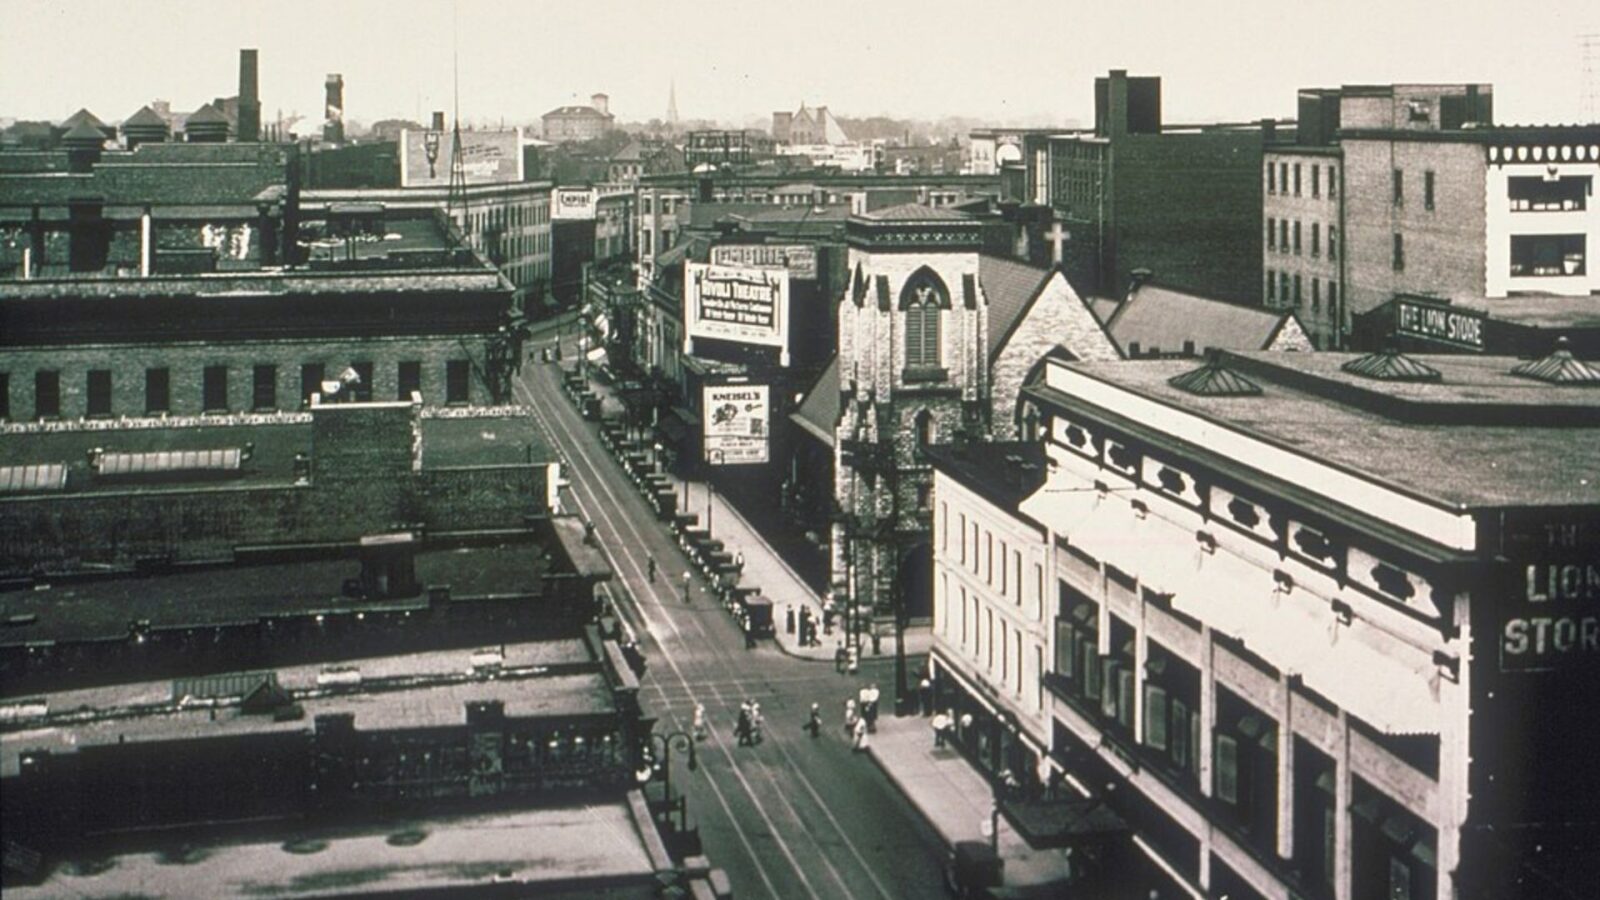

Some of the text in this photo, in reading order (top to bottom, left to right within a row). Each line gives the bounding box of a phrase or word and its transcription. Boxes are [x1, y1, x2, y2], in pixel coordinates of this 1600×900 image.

[732, 281, 772, 303] THEATRE
[1400, 303, 1482, 345] THE LION STORE
